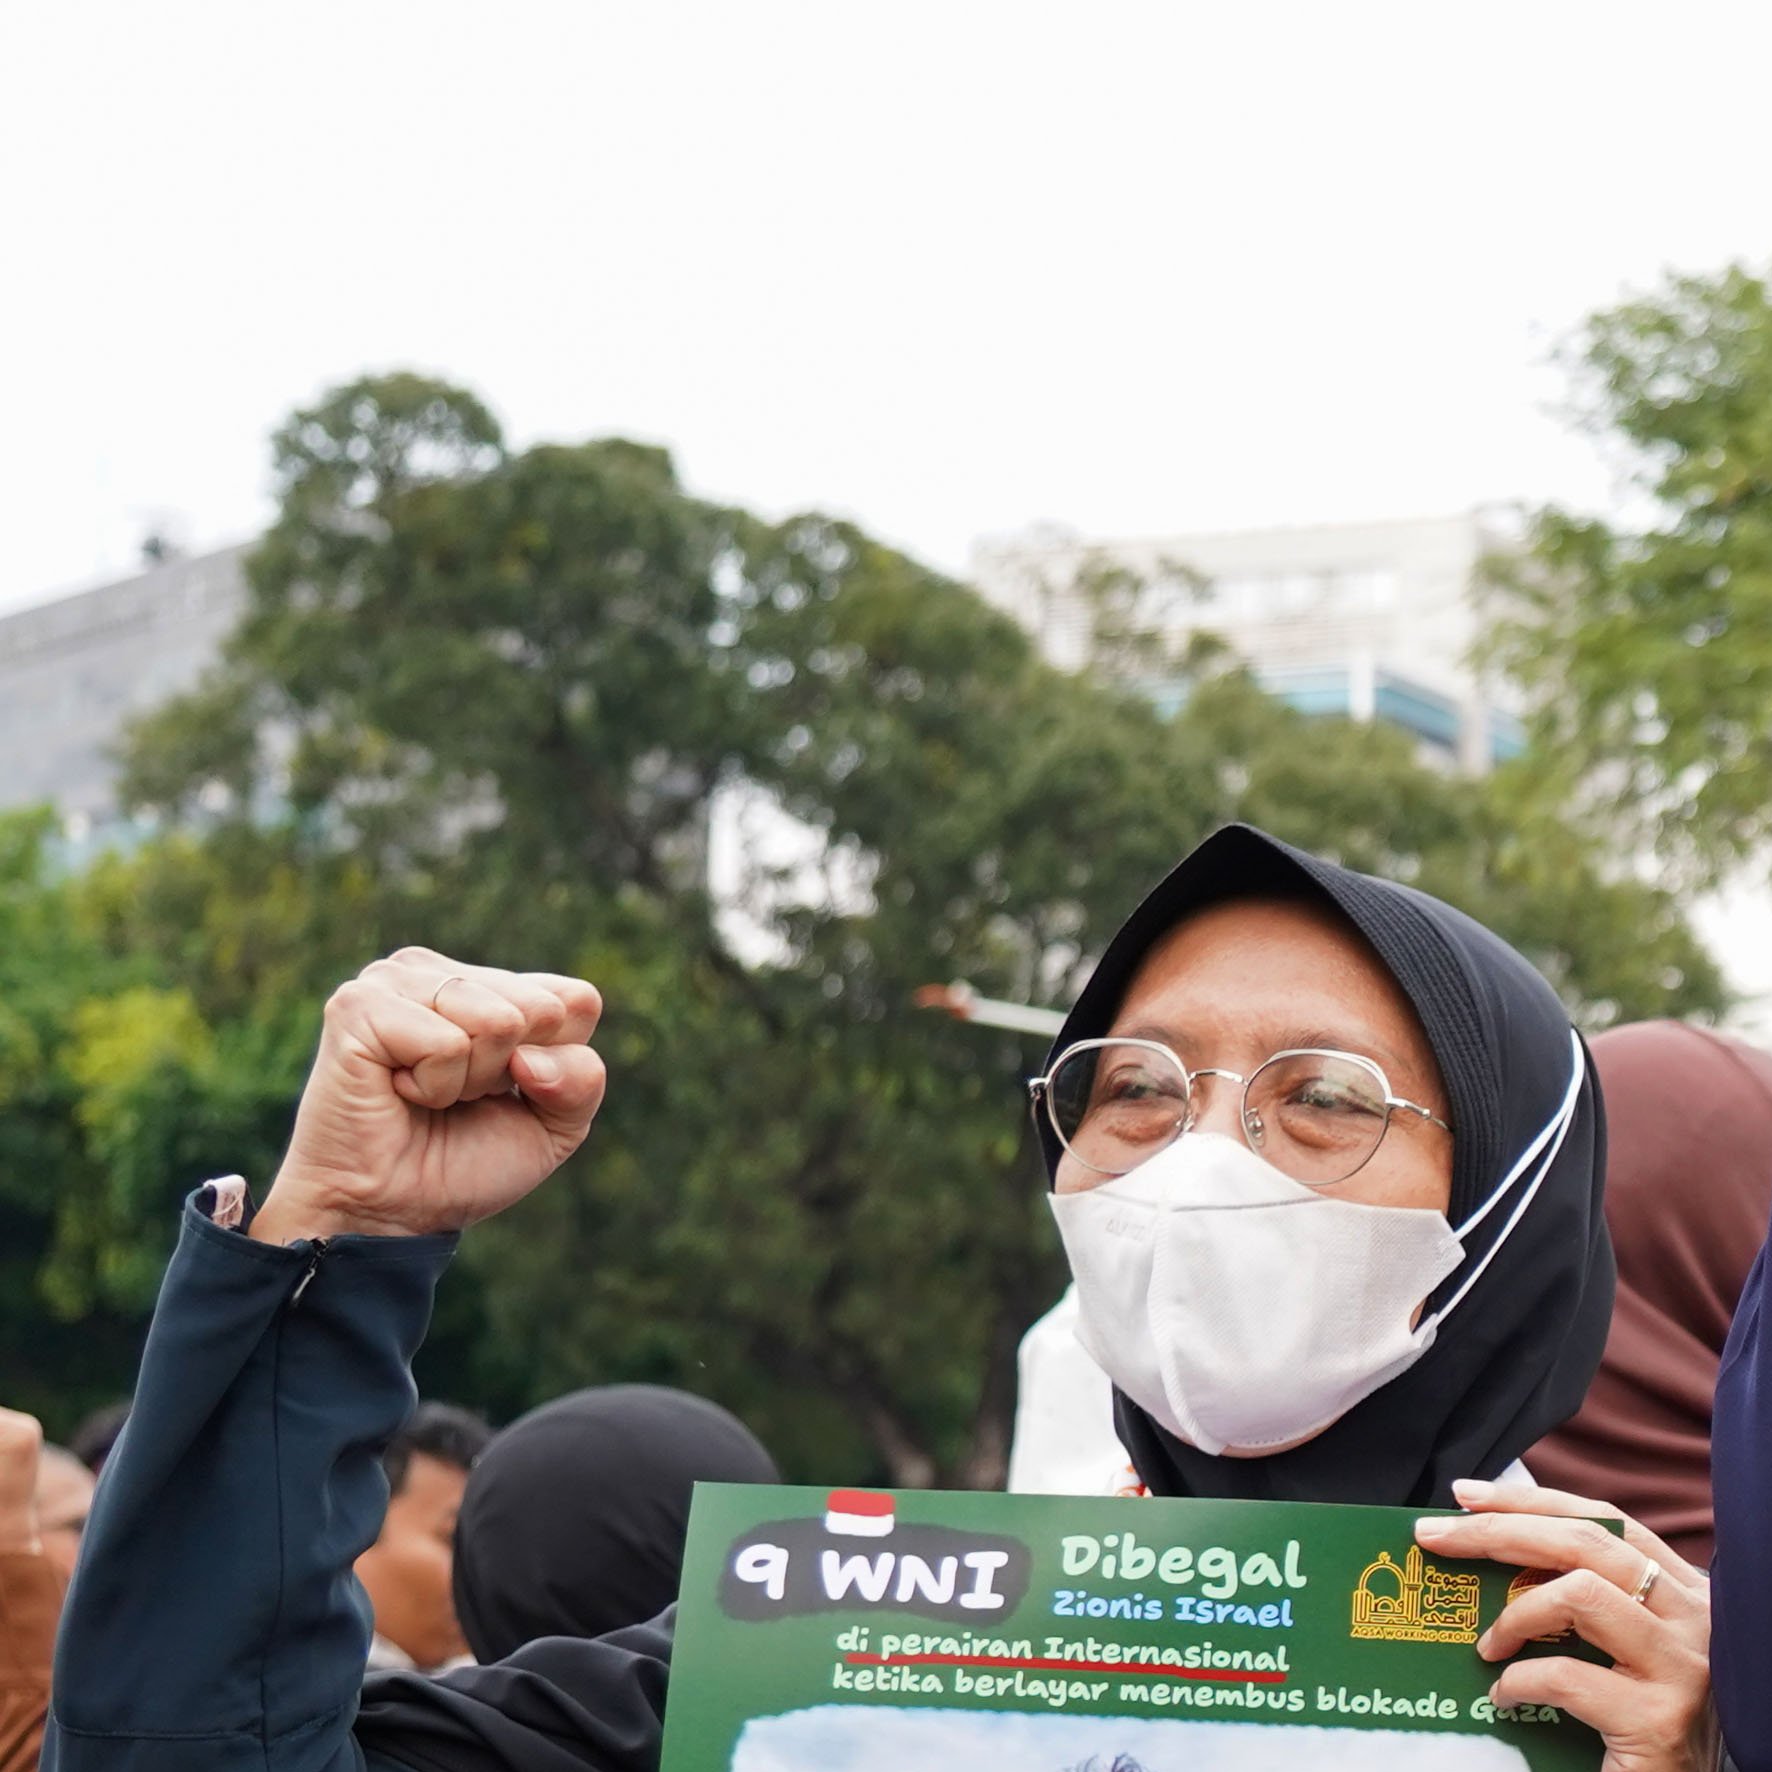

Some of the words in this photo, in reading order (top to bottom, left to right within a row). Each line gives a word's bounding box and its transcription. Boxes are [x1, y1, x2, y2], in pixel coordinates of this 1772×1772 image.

[735, 1543, 789, 1600] 9
[821, 1549, 1009, 1609] WNI
[1062, 1532, 1307, 1599] Dibegal
[1053, 1590, 1163, 1620] Zionis
[1175, 1596, 1294, 1628] Israel
[836, 1626, 870, 1652] di
[881, 1632, 1033, 1660] perairan
[1044, 1637, 1290, 1672] Internasional
[1351, 1627, 1384, 1639] AQSA
[1385, 1628, 1438, 1643] WORKING
[1439, 1631, 1479, 1644] GROUP
[832, 1663, 943, 1693] ketika
[955, 1668, 1109, 1707] berlayar
[1120, 1681, 1306, 1712] menembus
[1317, 1686, 1458, 1719] blokade
